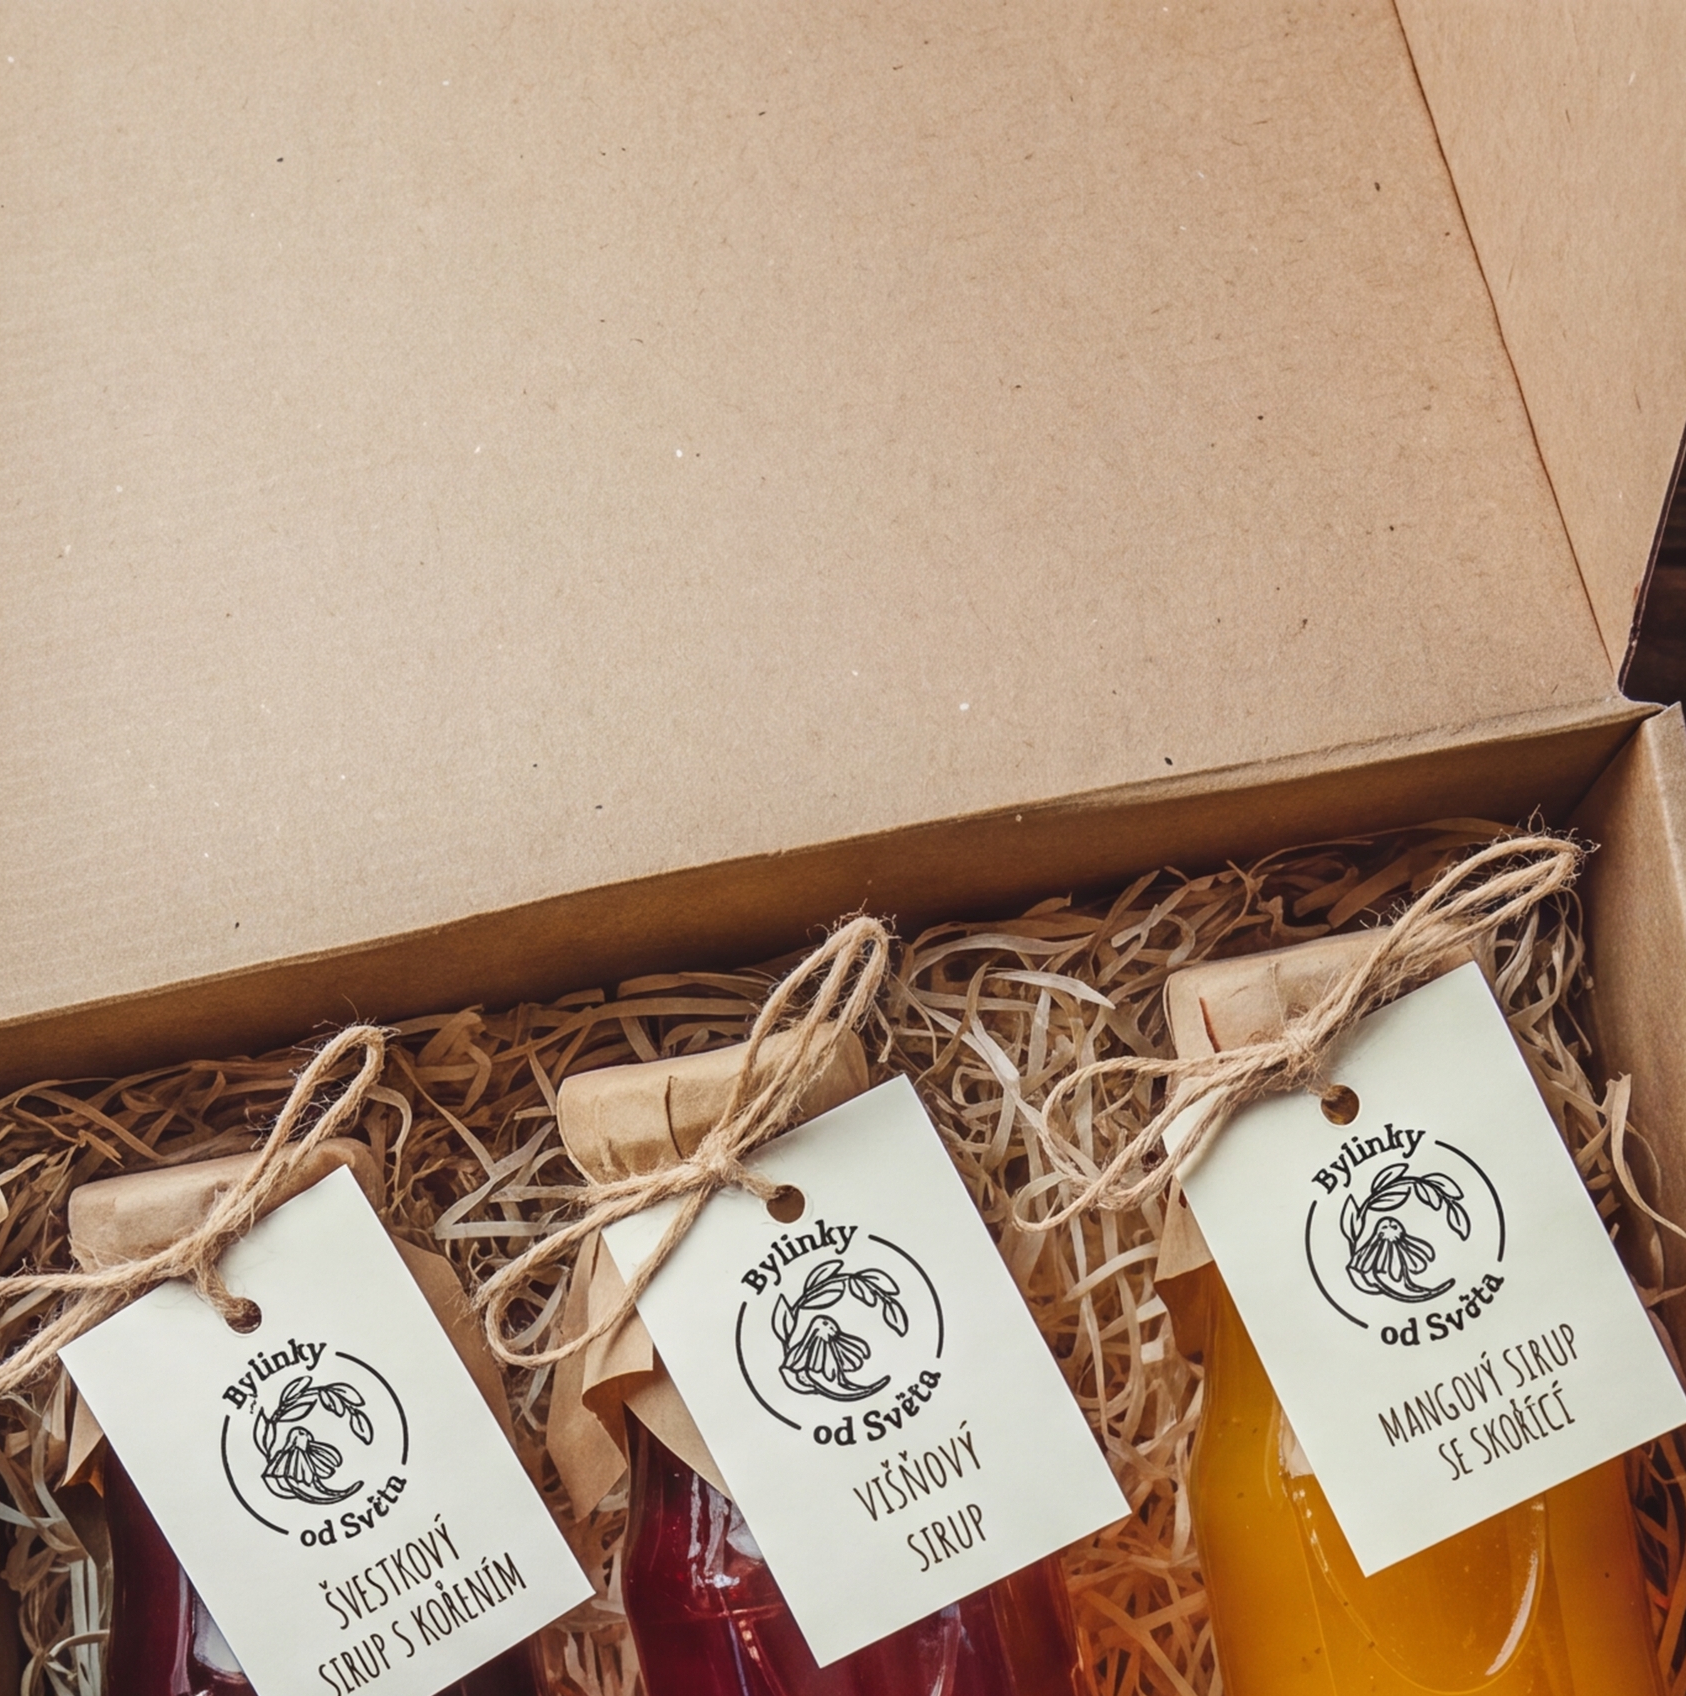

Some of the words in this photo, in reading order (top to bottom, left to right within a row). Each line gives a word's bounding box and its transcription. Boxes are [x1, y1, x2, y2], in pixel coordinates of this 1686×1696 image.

[1312, 1122, 1426, 1196] Bylinky
[740, 1219, 859, 1296] Bylinky
[1380, 1316, 1421, 1347] od
[222, 1338, 327, 1411] Bylinky
[1377, 1350, 1504, 1448] MANGOVÝ
[1502, 1322, 1578, 1388] SIRUP
[812, 1415, 857, 1447] od
[1437, 1437, 1474, 1481] SE
[1469, 1379, 1576, 1466] SKOŘÍCÍ
[853, 1420, 983, 1522] VIŠŇOVÝ
[299, 1518, 338, 1547] od
[906, 1503, 987, 1573] SIRUP
[318, 1513, 461, 1630] ŠVESTKOVÝ
[391, 1620, 416, 1658] S
[409, 1551, 528, 1647] KOŘENÍM
